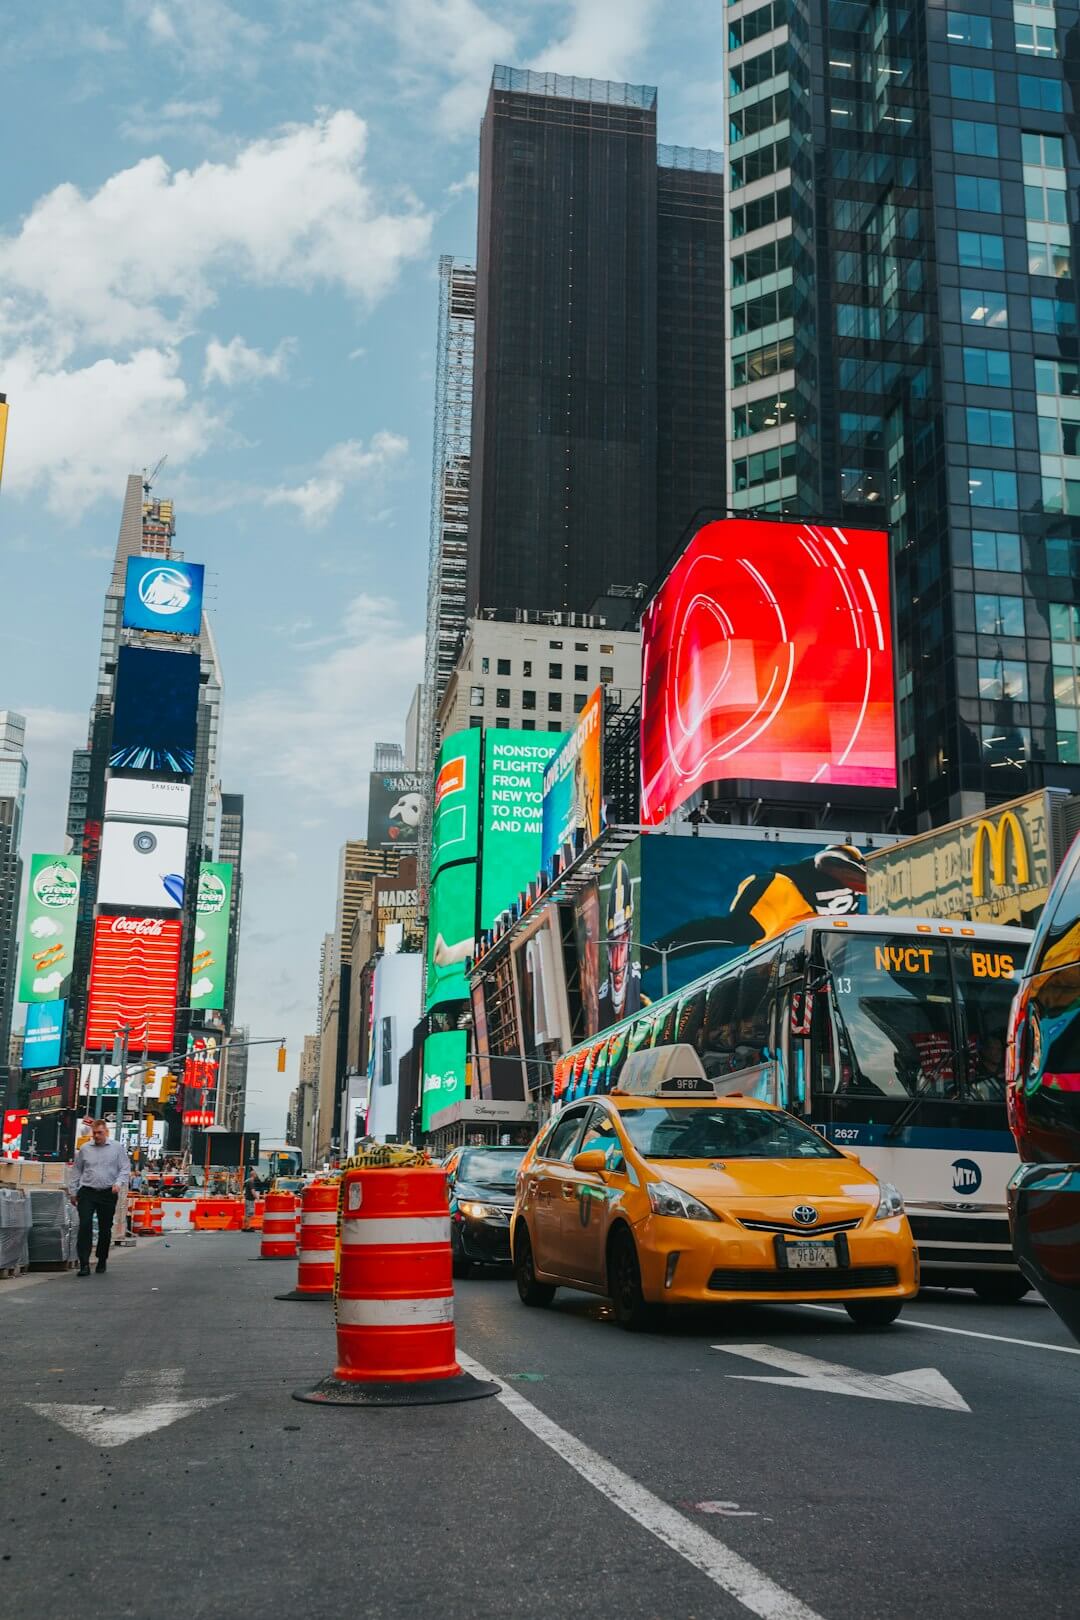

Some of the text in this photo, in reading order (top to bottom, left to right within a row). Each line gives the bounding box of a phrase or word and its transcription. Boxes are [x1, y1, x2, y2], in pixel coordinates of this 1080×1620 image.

[493, 744, 556, 759] NONSTOP
[493, 760, 545, 773] FLIGHTS
[151, 783, 185, 792] SAMSUNG
[384, 777, 424, 789] PHANTO
[492, 775, 531, 788] FROM
[492, 790, 543, 803] NEW YO
[491, 805, 543, 818] TO ROM
[491, 820, 521, 832] AND
[197, 893, 223, 903] reen
[378, 888, 422, 907] HADES
[111, 916, 167, 936] Coca-Cola
[875, 946, 1016, 979] NYCT BUS
[837, 977, 851, 994] 13
[677, 1080, 698, 1089] 9F87
[834, 1129, 859, 1139] 2627
[951, 1165, 977, 1188] MTA
